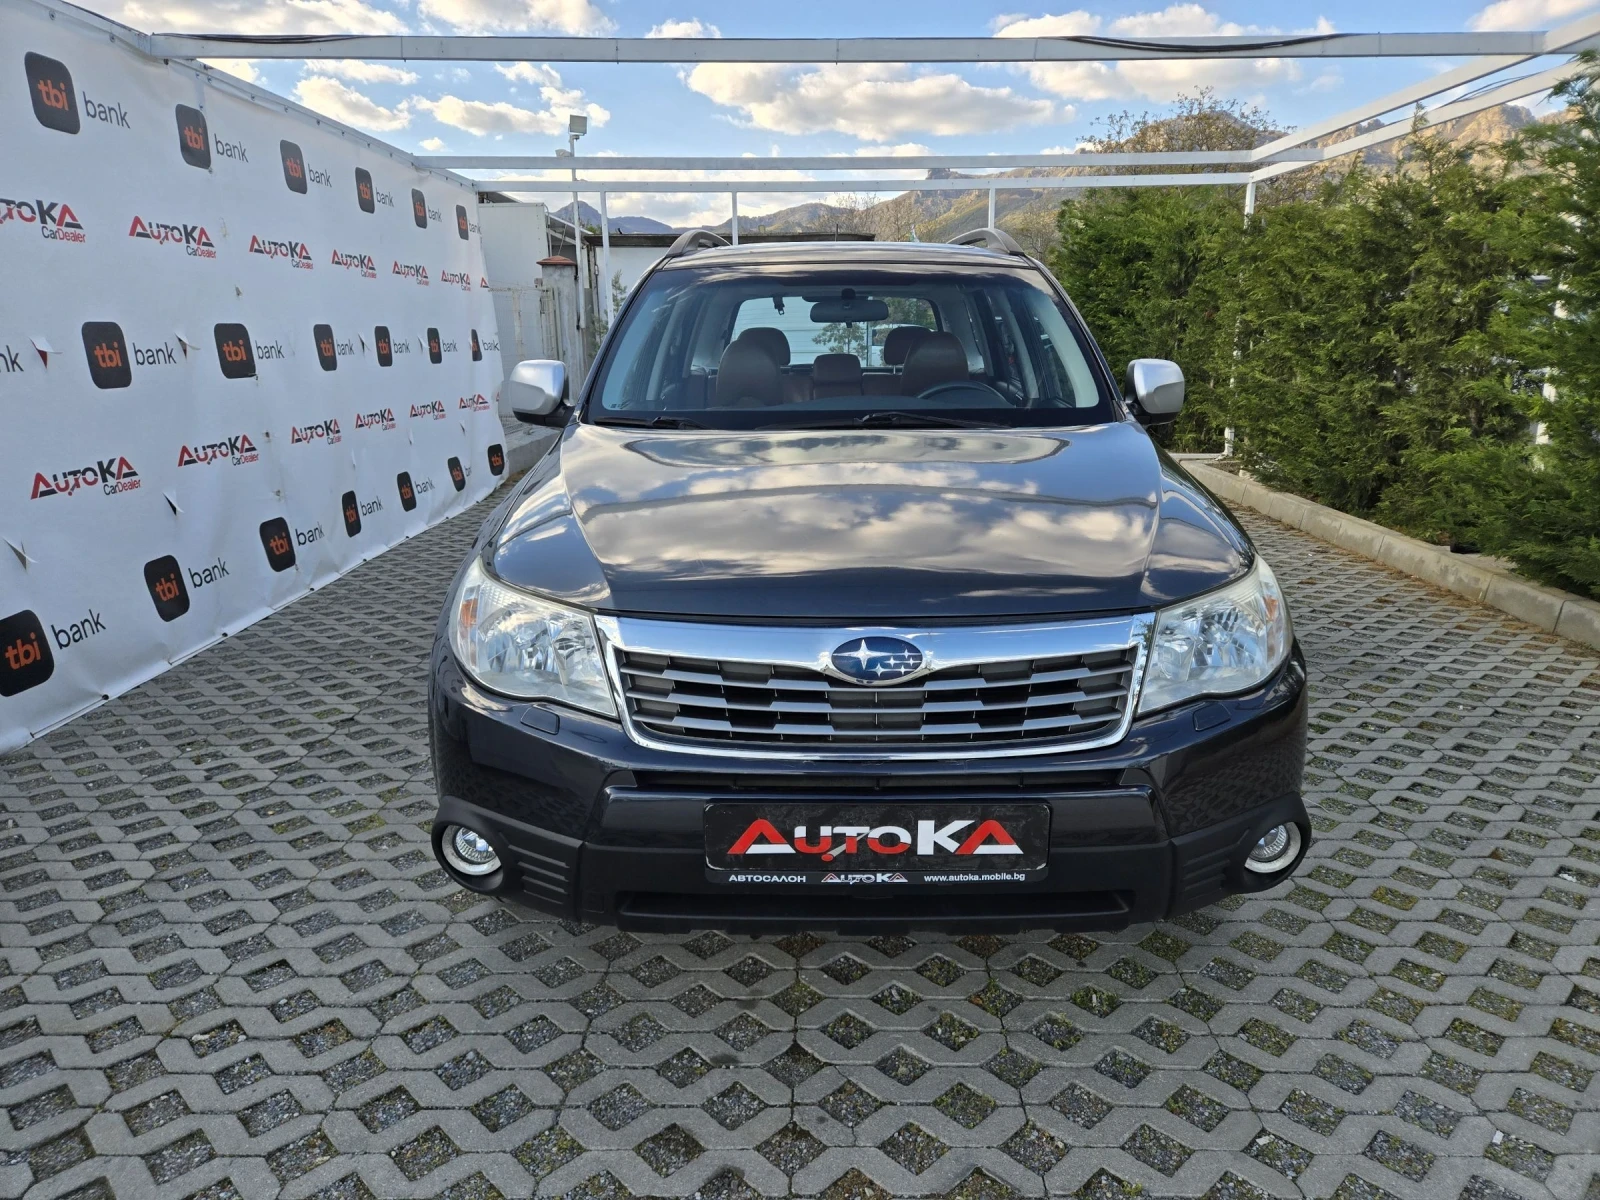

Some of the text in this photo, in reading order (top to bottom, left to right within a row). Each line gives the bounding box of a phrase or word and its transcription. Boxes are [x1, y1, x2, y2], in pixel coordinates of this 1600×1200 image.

[37, 80, 131, 129] tbi bank
[184, 126, 249, 163] tbi bank
[286, 158, 332, 188] tbi bank
[359, 182, 394, 208] tbi bank
[0, 198, 84, 230] TOKA
[415, 200, 442, 222] tbi bank
[41, 226, 86, 243] CarDealer
[186, 245, 217, 259] CarDealer
[0, 345, 24, 372] nk
[94, 342, 177, 368] tbi bank
[222, 339, 285, 361] tbi bank
[320, 338, 355, 357] tbi bank
[378, 338, 410, 355] tbi bank
[231, 452, 259, 466] CarDealer
[103, 479, 141, 496] CarDealer
[401, 477, 436, 499] tbi bank
[345, 496, 384, 523] tbi bank
[269, 522, 325, 556] tbi bank
[155, 557, 230, 602] tbi bank
[5, 609, 107, 670] tbi bank
[728, 874, 807, 883] АВТОСАЛОН
[924, 873, 1026, 882] www.autoka.mobile.bg
